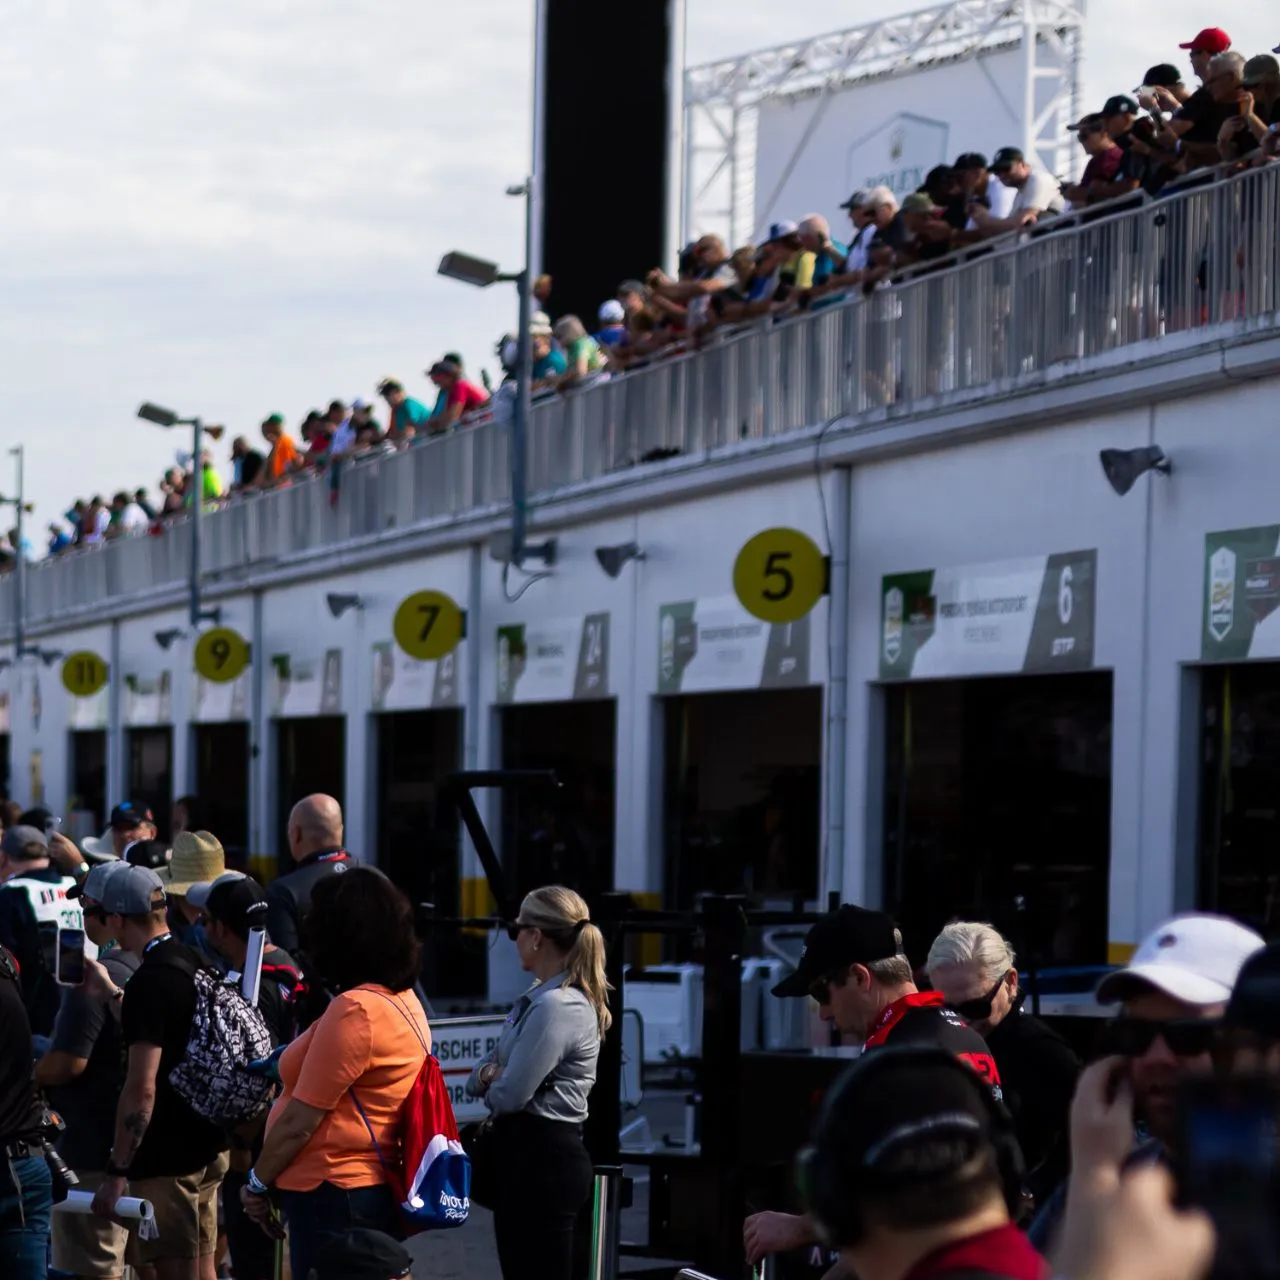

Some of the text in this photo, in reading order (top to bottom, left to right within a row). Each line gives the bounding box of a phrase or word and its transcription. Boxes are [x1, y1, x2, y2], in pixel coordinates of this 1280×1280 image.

[759, 551, 794, 601] 5
[1059, 565, 1073, 624] 6
[416, 604, 442, 643] 7
[211, 637, 231, 670] 9
[73, 658, 97, 687] 11
[439, 1189, 470, 1210] TOYOTA
